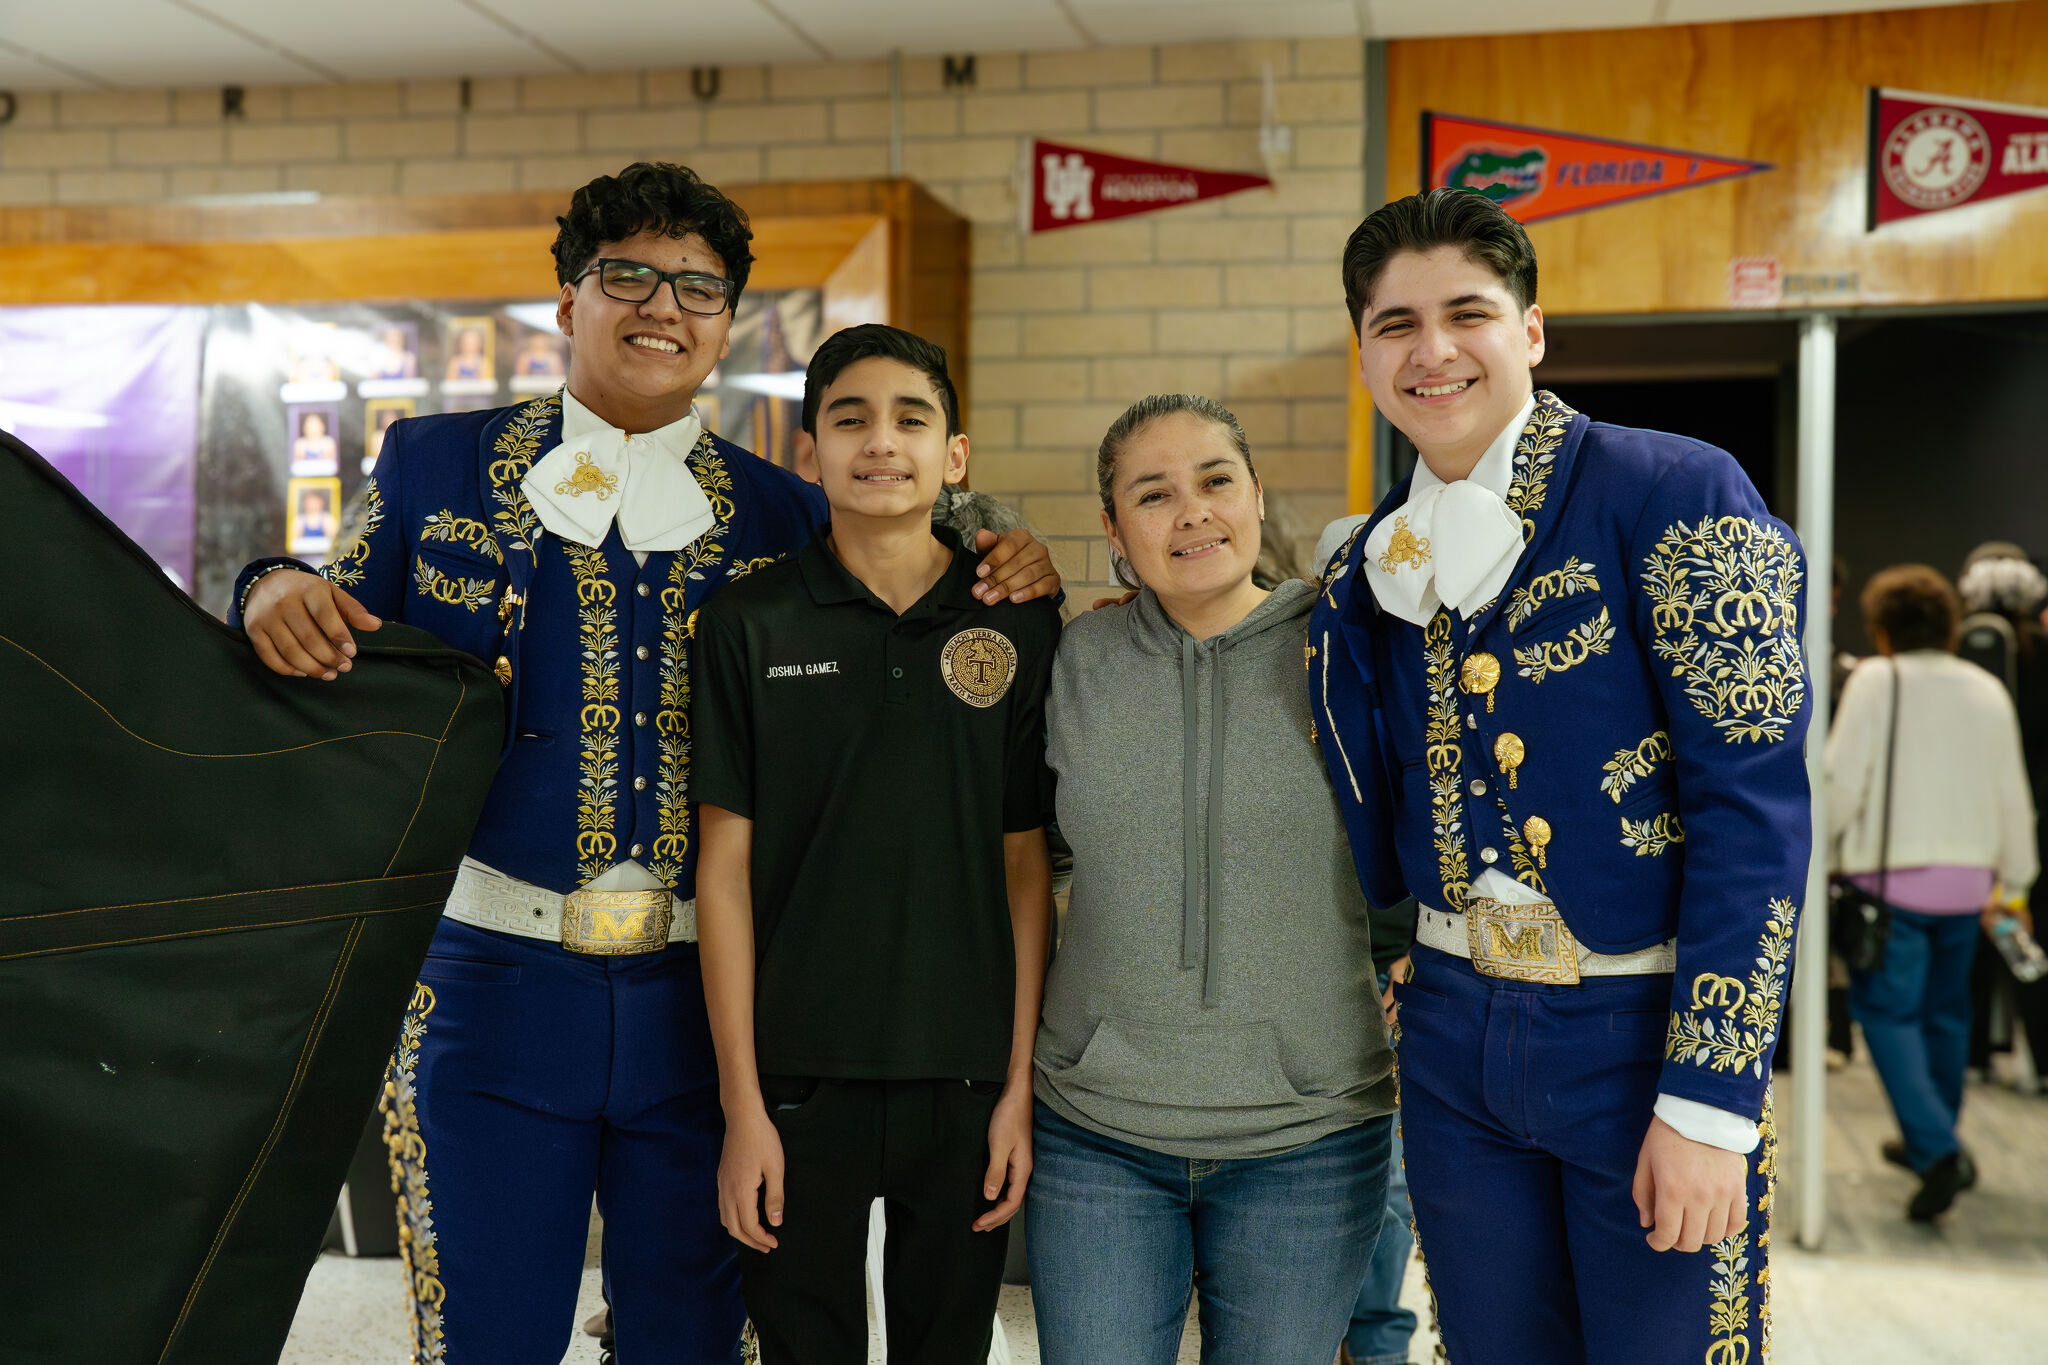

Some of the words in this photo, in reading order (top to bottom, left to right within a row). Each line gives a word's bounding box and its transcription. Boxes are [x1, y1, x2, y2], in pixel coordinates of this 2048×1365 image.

[1042, 153, 1094, 219] UH
[1555, 158, 1665, 187] FLORIDA
[944, 632, 969, 660] MARIACHI
[971, 631, 997, 641] TIERRA
[998, 638, 1016, 668] DORADA
[766, 664, 803, 678] JOSHUA
[805, 661, 838, 675] GAMEZ
[967, 658, 995, 685] T
[946, 672, 967, 696] TRAVIS
[966, 694, 990, 704] MIDDLE
[991, 680, 1011, 702] SCHOOL
[589, 910, 649, 940] M
[1487, 920, 1545, 961] M
